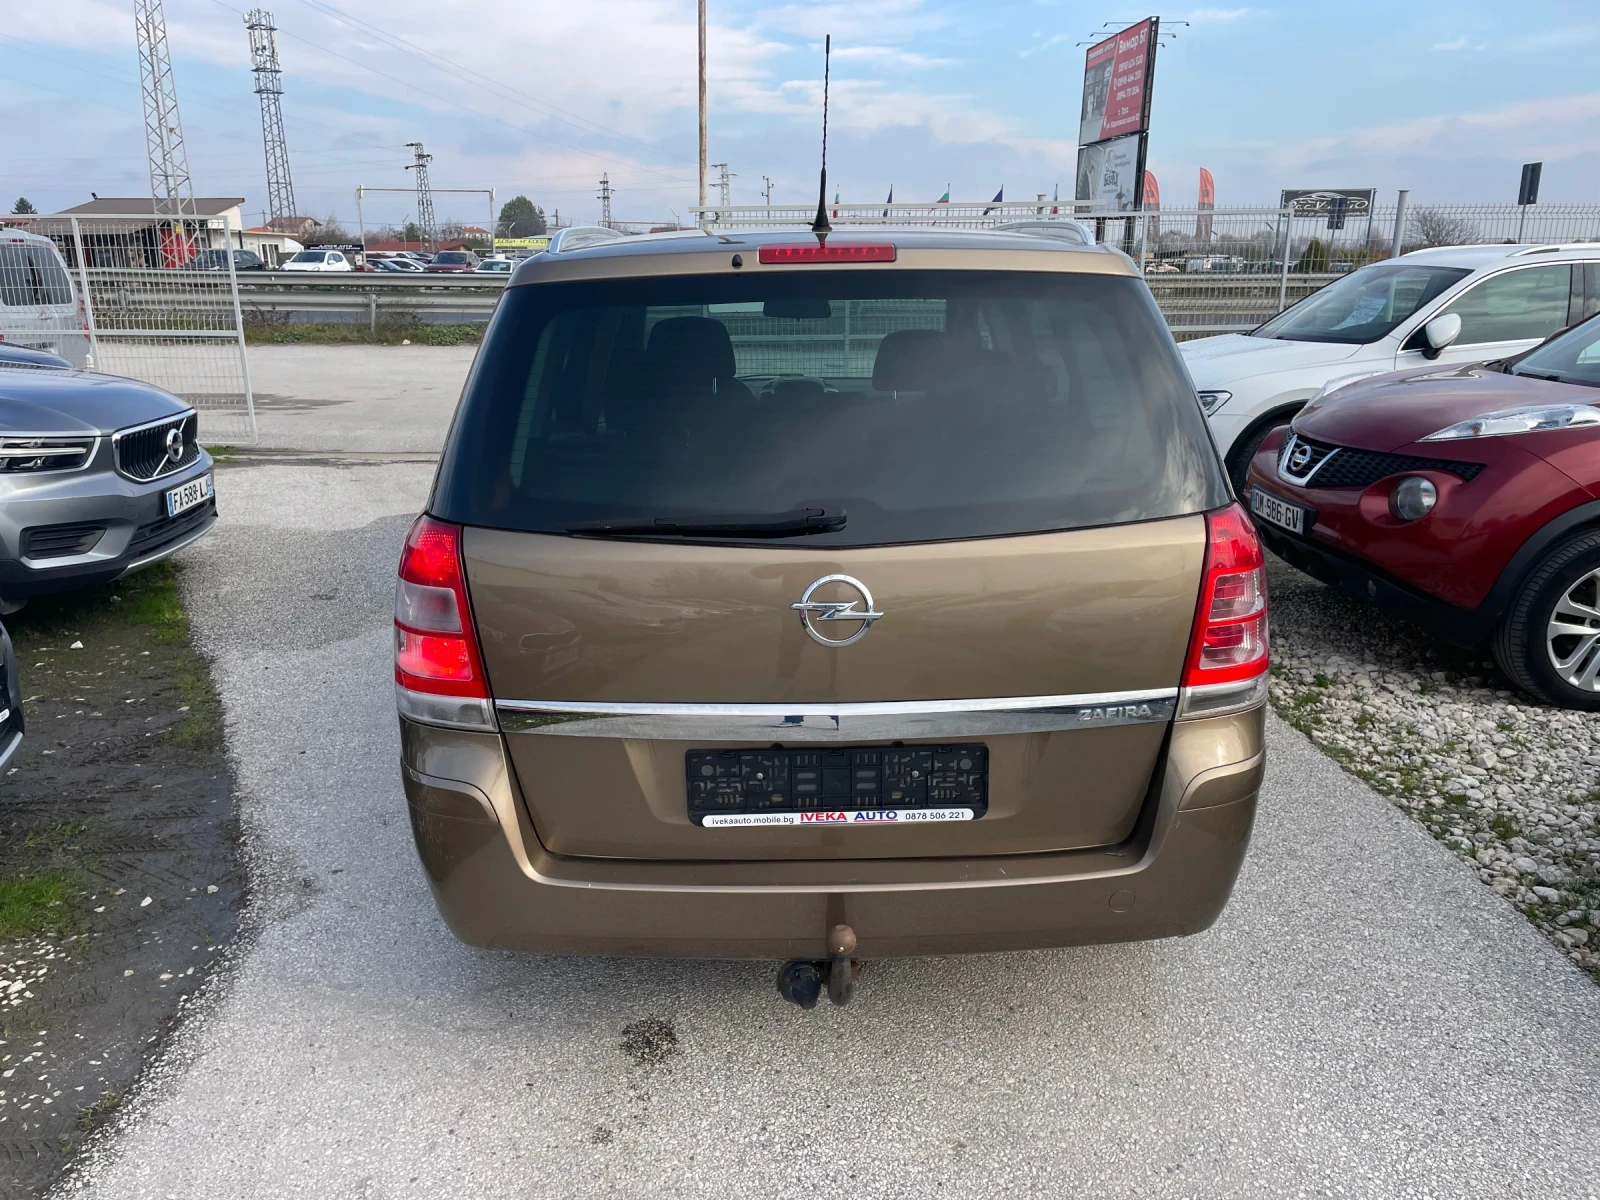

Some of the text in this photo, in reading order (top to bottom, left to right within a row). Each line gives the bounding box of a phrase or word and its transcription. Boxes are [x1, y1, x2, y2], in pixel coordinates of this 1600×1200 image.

[1077, 704, 1152, 721] ZAFIRA
[711, 810, 965, 825] ivekaauto.mobile.bg IVEKA AUTO 0878 506 221
